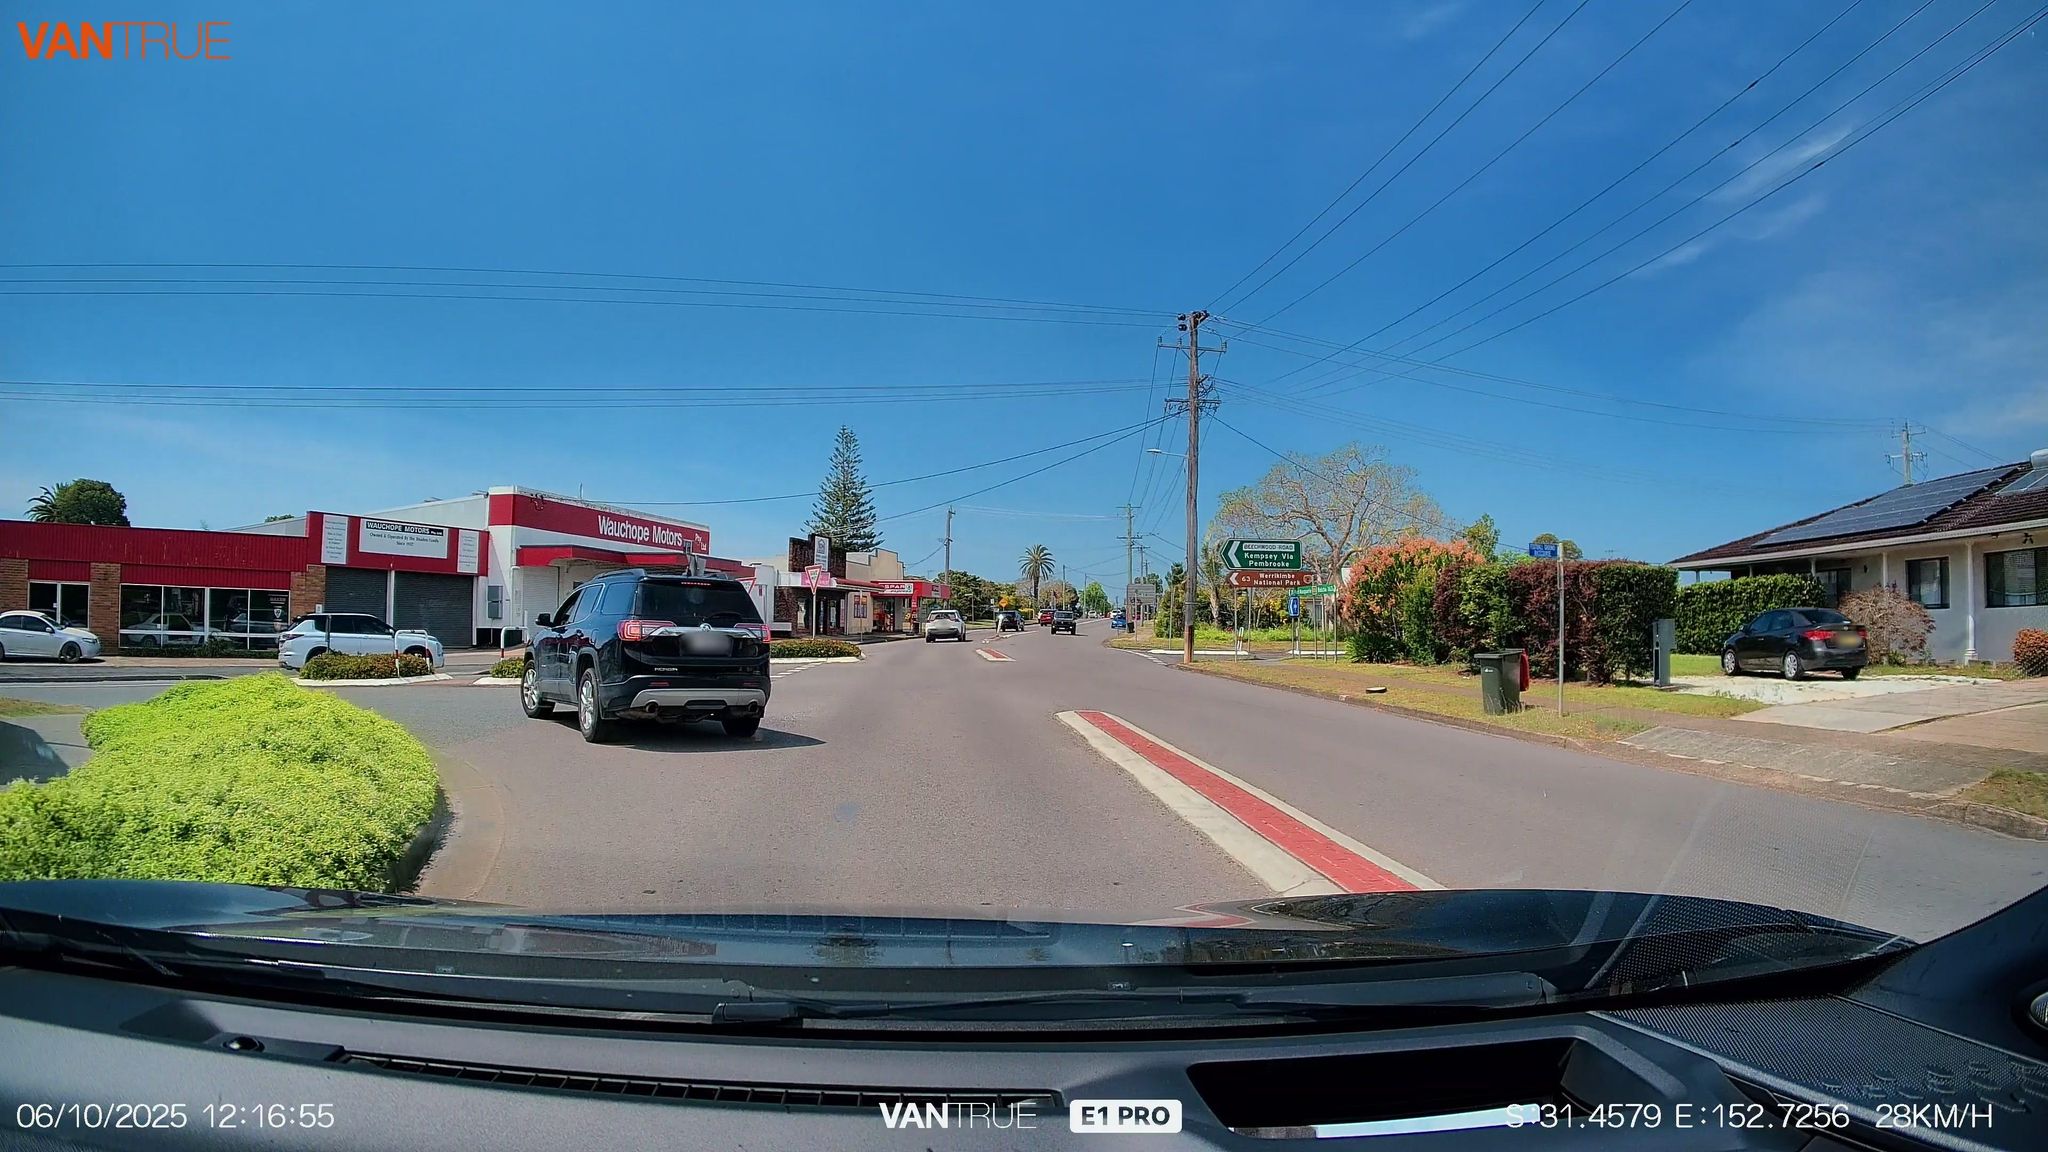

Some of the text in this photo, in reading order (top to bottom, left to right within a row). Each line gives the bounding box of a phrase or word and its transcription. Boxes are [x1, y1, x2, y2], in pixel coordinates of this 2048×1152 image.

[367, 521, 402, 532] WAUCHOPE
[404, 525, 430, 534] MOTORS
[598, 515, 683, 547] Wauchope Motors
[1244, 552, 1278, 561] Kempsey
